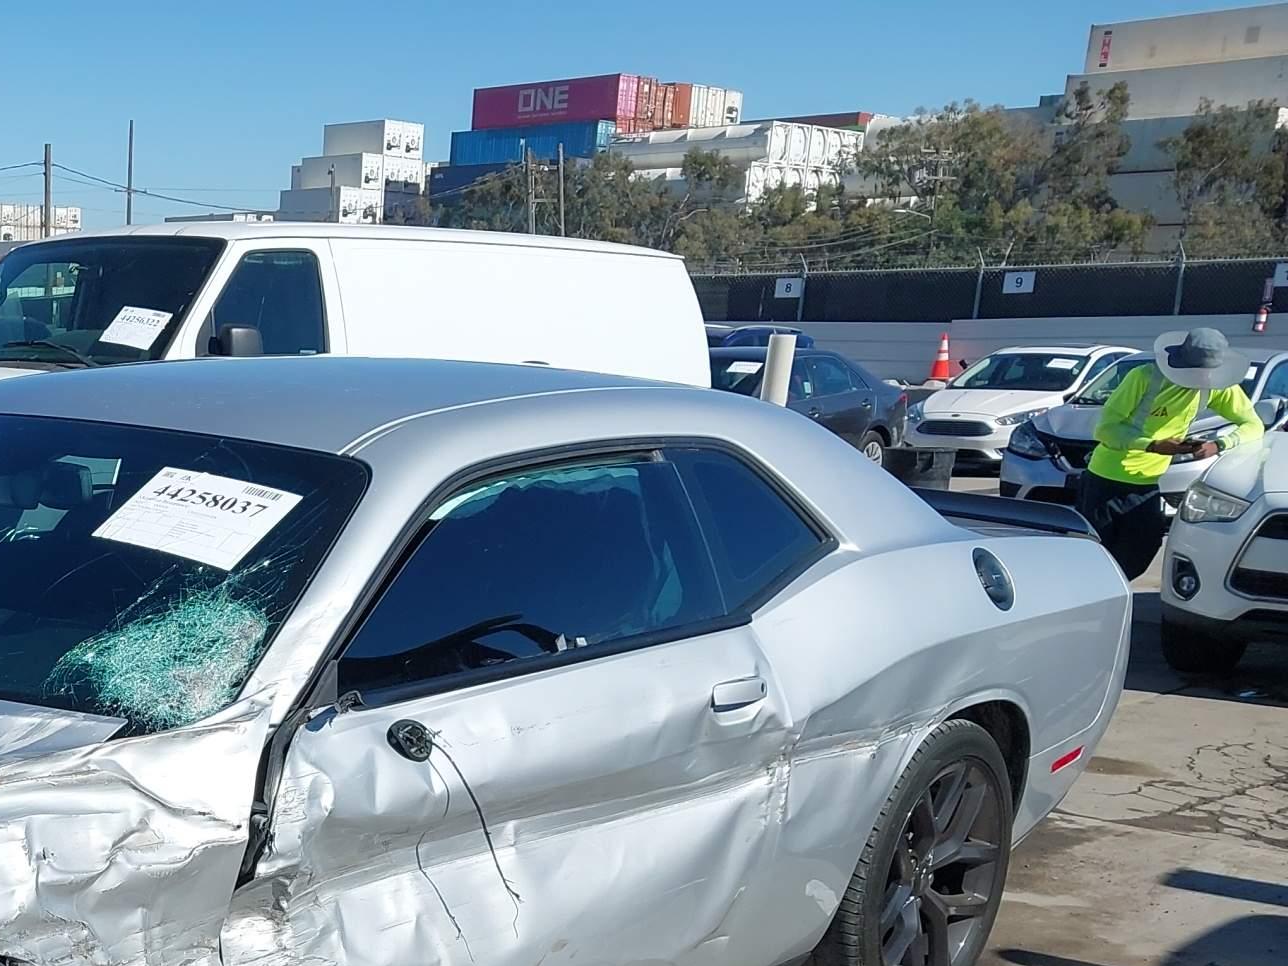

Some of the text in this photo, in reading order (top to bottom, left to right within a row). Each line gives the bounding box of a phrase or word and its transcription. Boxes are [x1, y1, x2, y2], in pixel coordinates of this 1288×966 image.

[518, 85, 569, 112] ONE
[784, 282, 792, 293] 8
[1015, 276, 1024, 288] 9
[153, 484, 269, 518] 44258037
